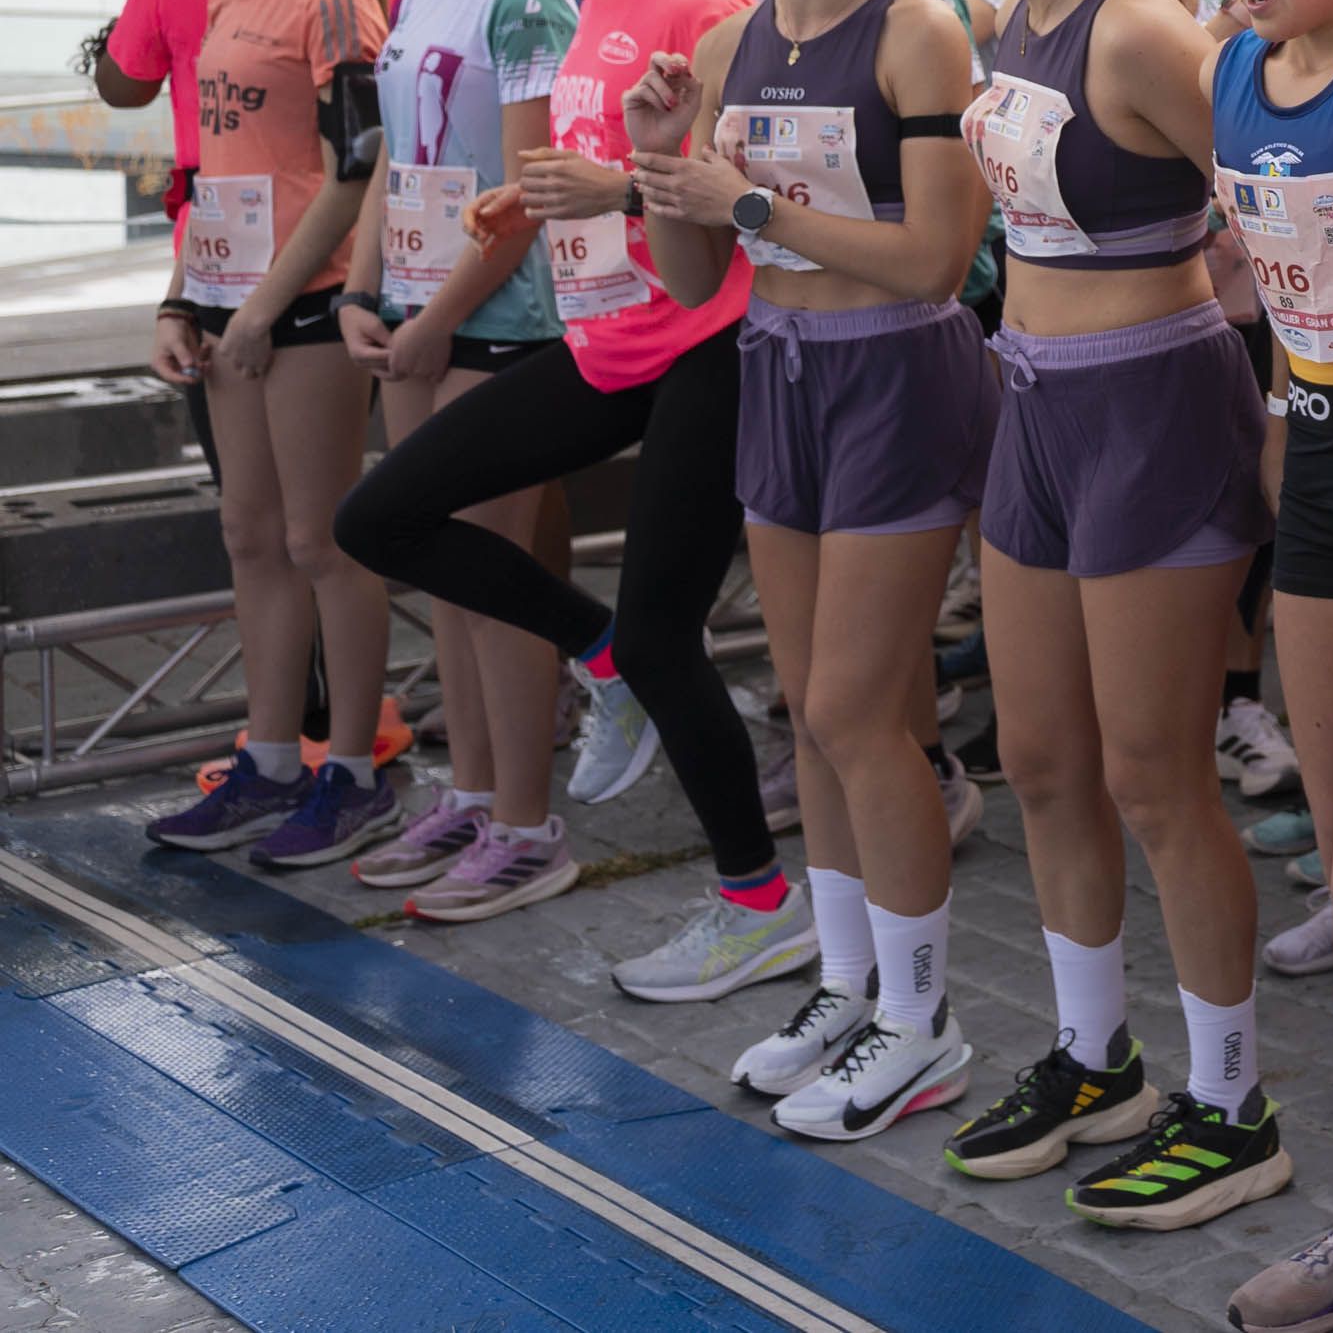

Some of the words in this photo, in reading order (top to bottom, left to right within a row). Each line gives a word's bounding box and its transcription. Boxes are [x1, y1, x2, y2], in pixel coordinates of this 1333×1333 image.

[760, 86, 805, 101] OYSHO
[986, 156, 1018, 194] 016
[551, 237, 587, 261] 16
[1253, 257, 1310, 293] 016
[1279, 296, 1294, 309] 89
[1305, 317, 1329, 328] GRAN
[1287, 379, 1331, 422] PRO
[912, 944, 933, 994] OYSHO
[1224, 1032, 1242, 1081] OYSHO
